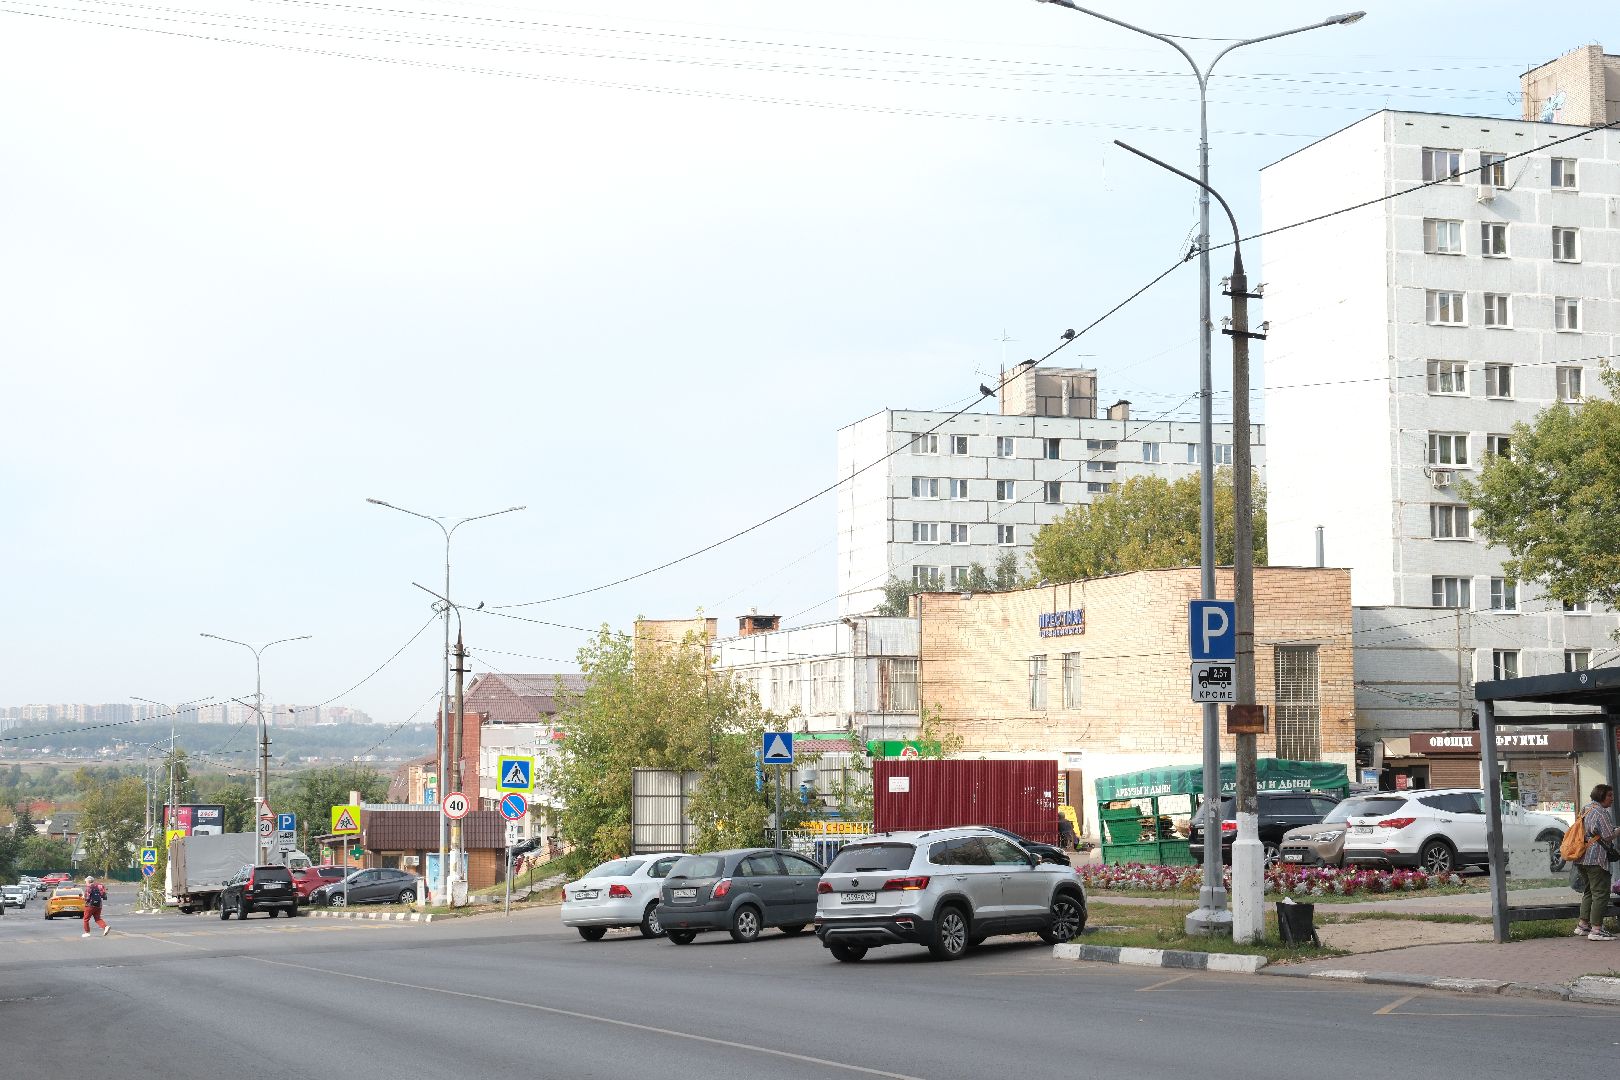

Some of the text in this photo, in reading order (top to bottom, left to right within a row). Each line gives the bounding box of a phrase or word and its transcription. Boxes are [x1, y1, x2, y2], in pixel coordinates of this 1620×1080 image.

[1202, 606, 1229, 654] P
[1199, 691, 1233, 699] КРОМЕ
[1429, 734, 1549, 749] ОВОЩИ ФРУКТЫ
[1116, 787, 1143, 798] АРБУЗЫ
[1150, 784, 1171, 795] ДЫНИ
[1222, 779, 1311, 791] АРЫ И ДЫНИ
[450, 800, 463, 811] 40
[260, 823, 270, 832] 20
[282, 815, 292, 829] P
